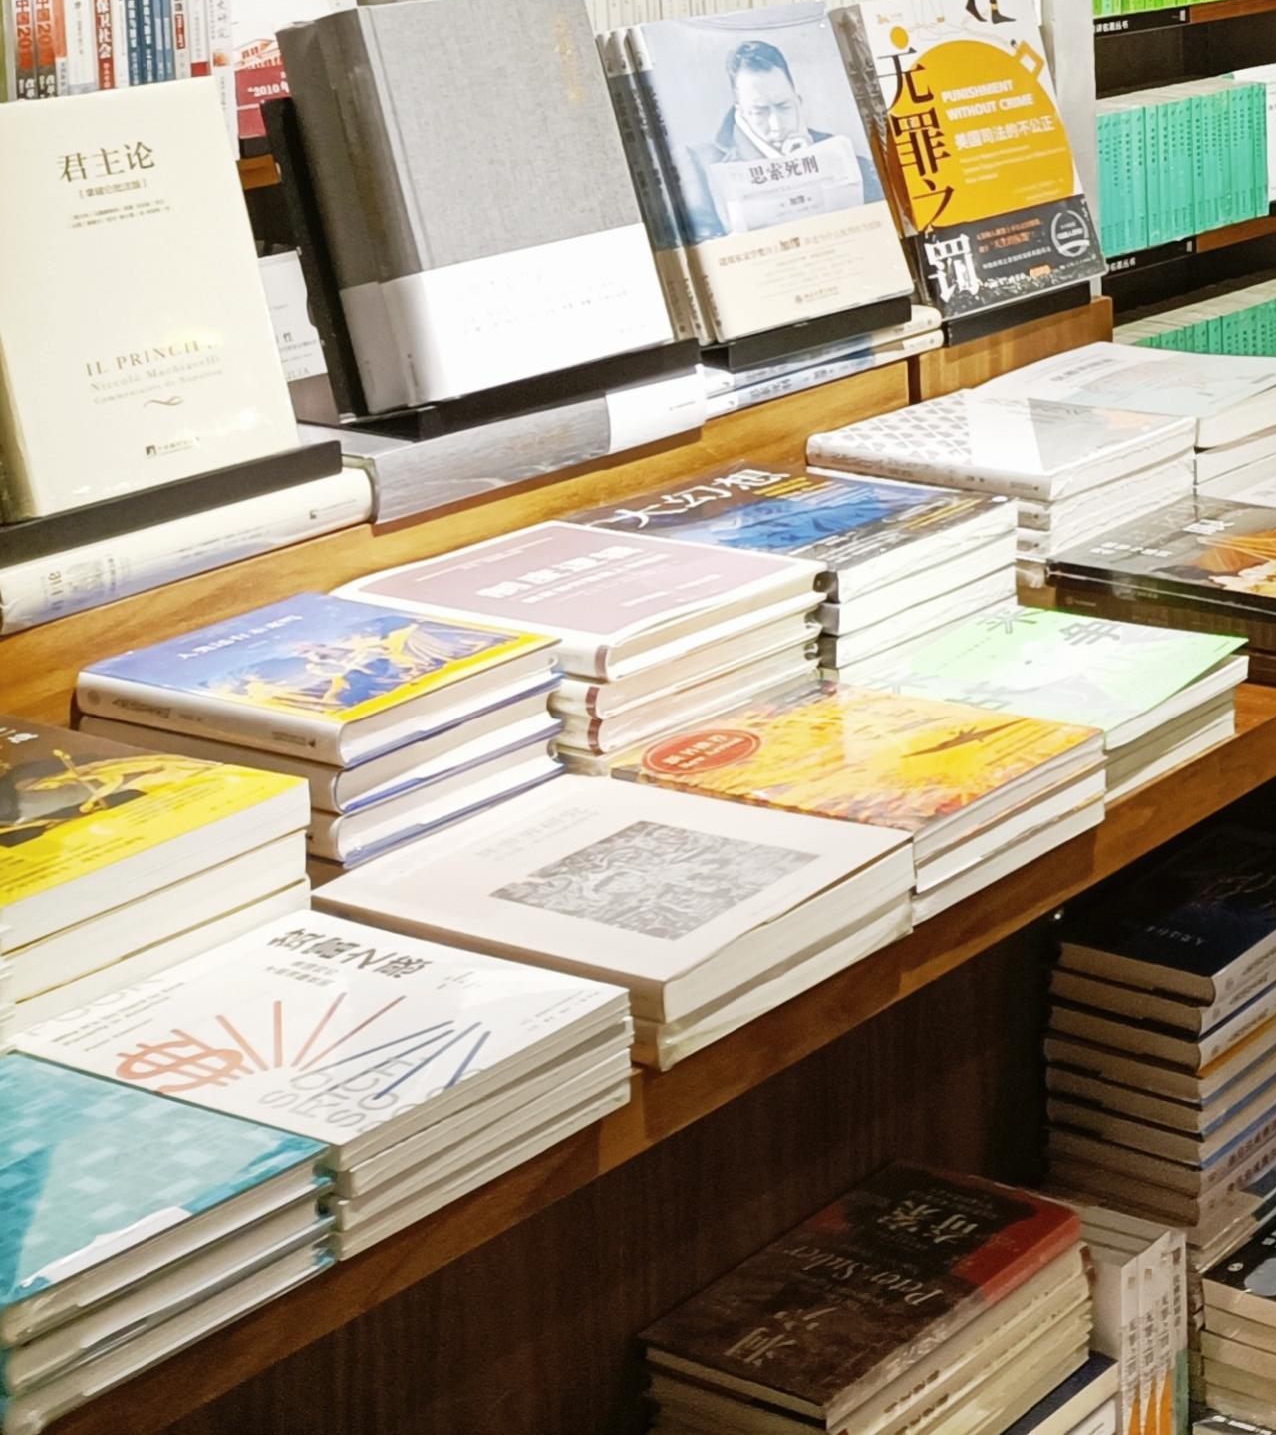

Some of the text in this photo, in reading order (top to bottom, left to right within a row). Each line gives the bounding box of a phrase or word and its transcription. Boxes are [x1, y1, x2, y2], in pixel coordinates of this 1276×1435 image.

[941, 78, 1014, 103] PUNISHMENT
[945, 93, 1034, 121] WITHOUT CRIME
[954, 115, 1054, 150] 美国司法的不公正
[56, 141, 155, 183] 君主论
[749, 155, 820, 185] 思索死刑
[876, 46, 982, 304] 无罪之罚
[85, 360, 107, 377] IL
[611, 467, 792, 529] 大幻想
[475, 545, 643, 599] 制度逻辑
[266, 926, 426, 979] 贫富之惑
[875, 1199, 981, 1245] 奇案
[873, 1272, 945, 1307] Peter
[722, 1306, 839, 1368] 洞穴
